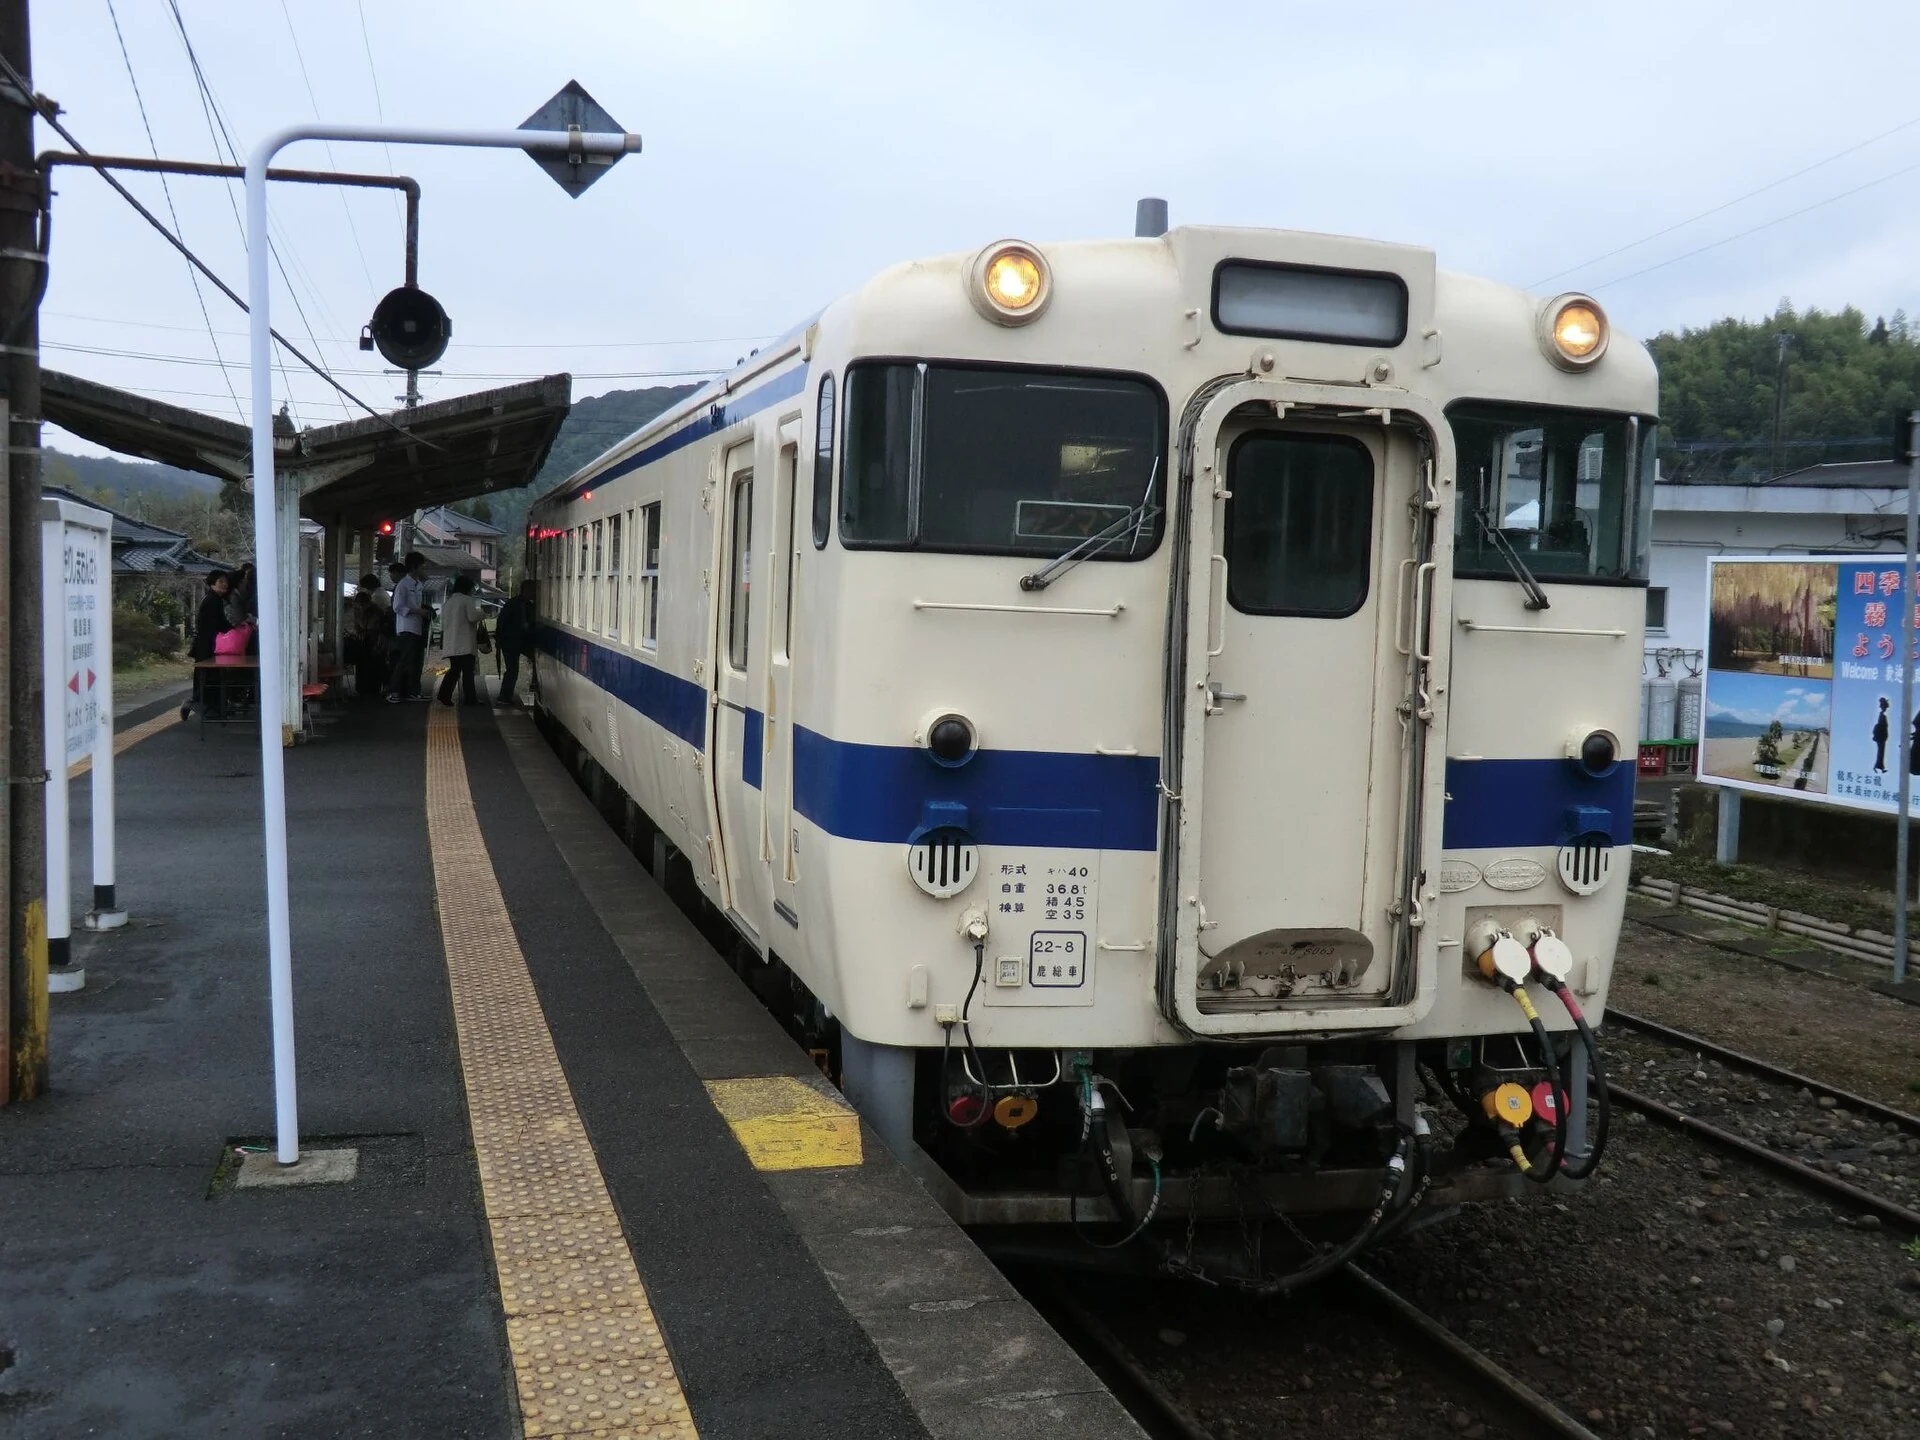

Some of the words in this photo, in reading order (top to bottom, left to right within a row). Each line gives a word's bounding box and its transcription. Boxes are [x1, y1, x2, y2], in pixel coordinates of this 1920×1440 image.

[1841, 661, 1879, 681] Welcome
[1000, 864, 1027, 876] 形式
[1001, 883, 1026, 894] 自重
[1045, 909, 1058, 920] 空
[1034, 940, 1075, 953] 22-8
